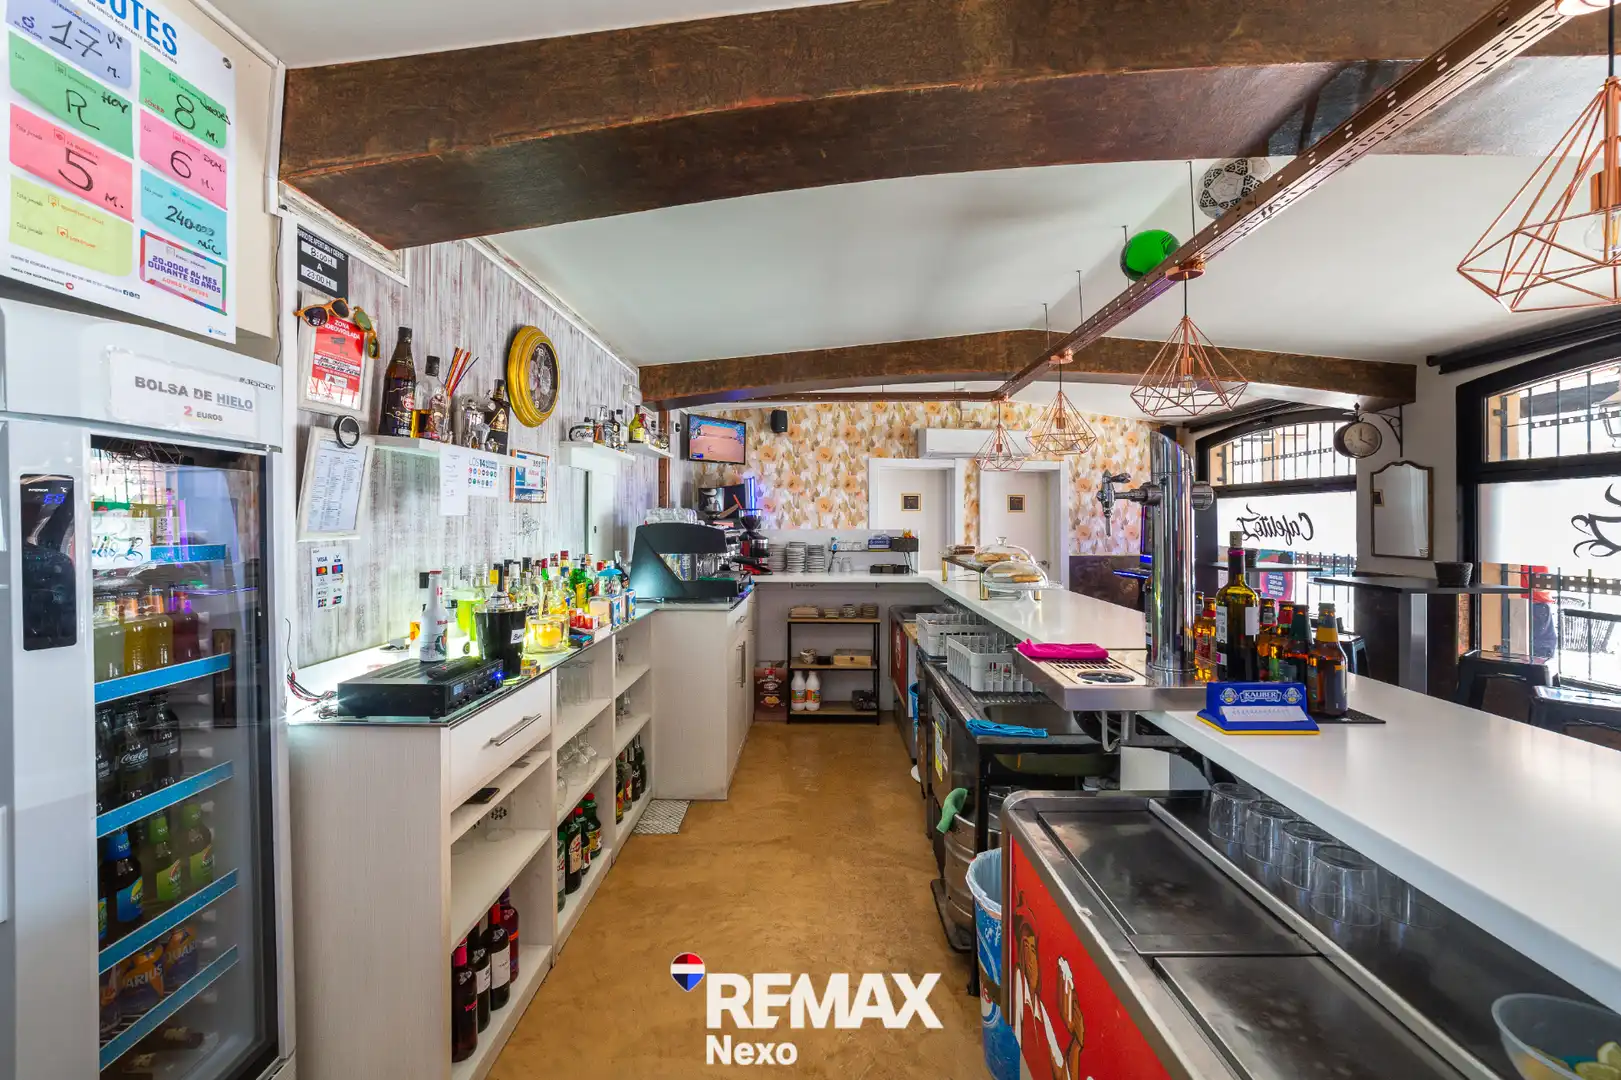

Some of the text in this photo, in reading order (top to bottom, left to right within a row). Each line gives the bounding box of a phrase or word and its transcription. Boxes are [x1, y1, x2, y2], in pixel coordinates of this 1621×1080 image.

[49, 20, 103, 58] 17
[96, 0, 178, 56] OTES
[101, 91, 129, 113] HOY
[174, 94, 196, 130] 8
[58, 147, 98, 192] 5
[170, 150, 193, 179] 6
[147, 260, 189, 282] DURANTE
[317, 263, 323, 272] A
[323, 323, 361, 340] IDEOVIGILADA
[334, 319, 350, 330] ZONA
[134, 375, 254, 411] BOLSA DE HIELO
[183, 405, 223, 422] 2 EUROS
